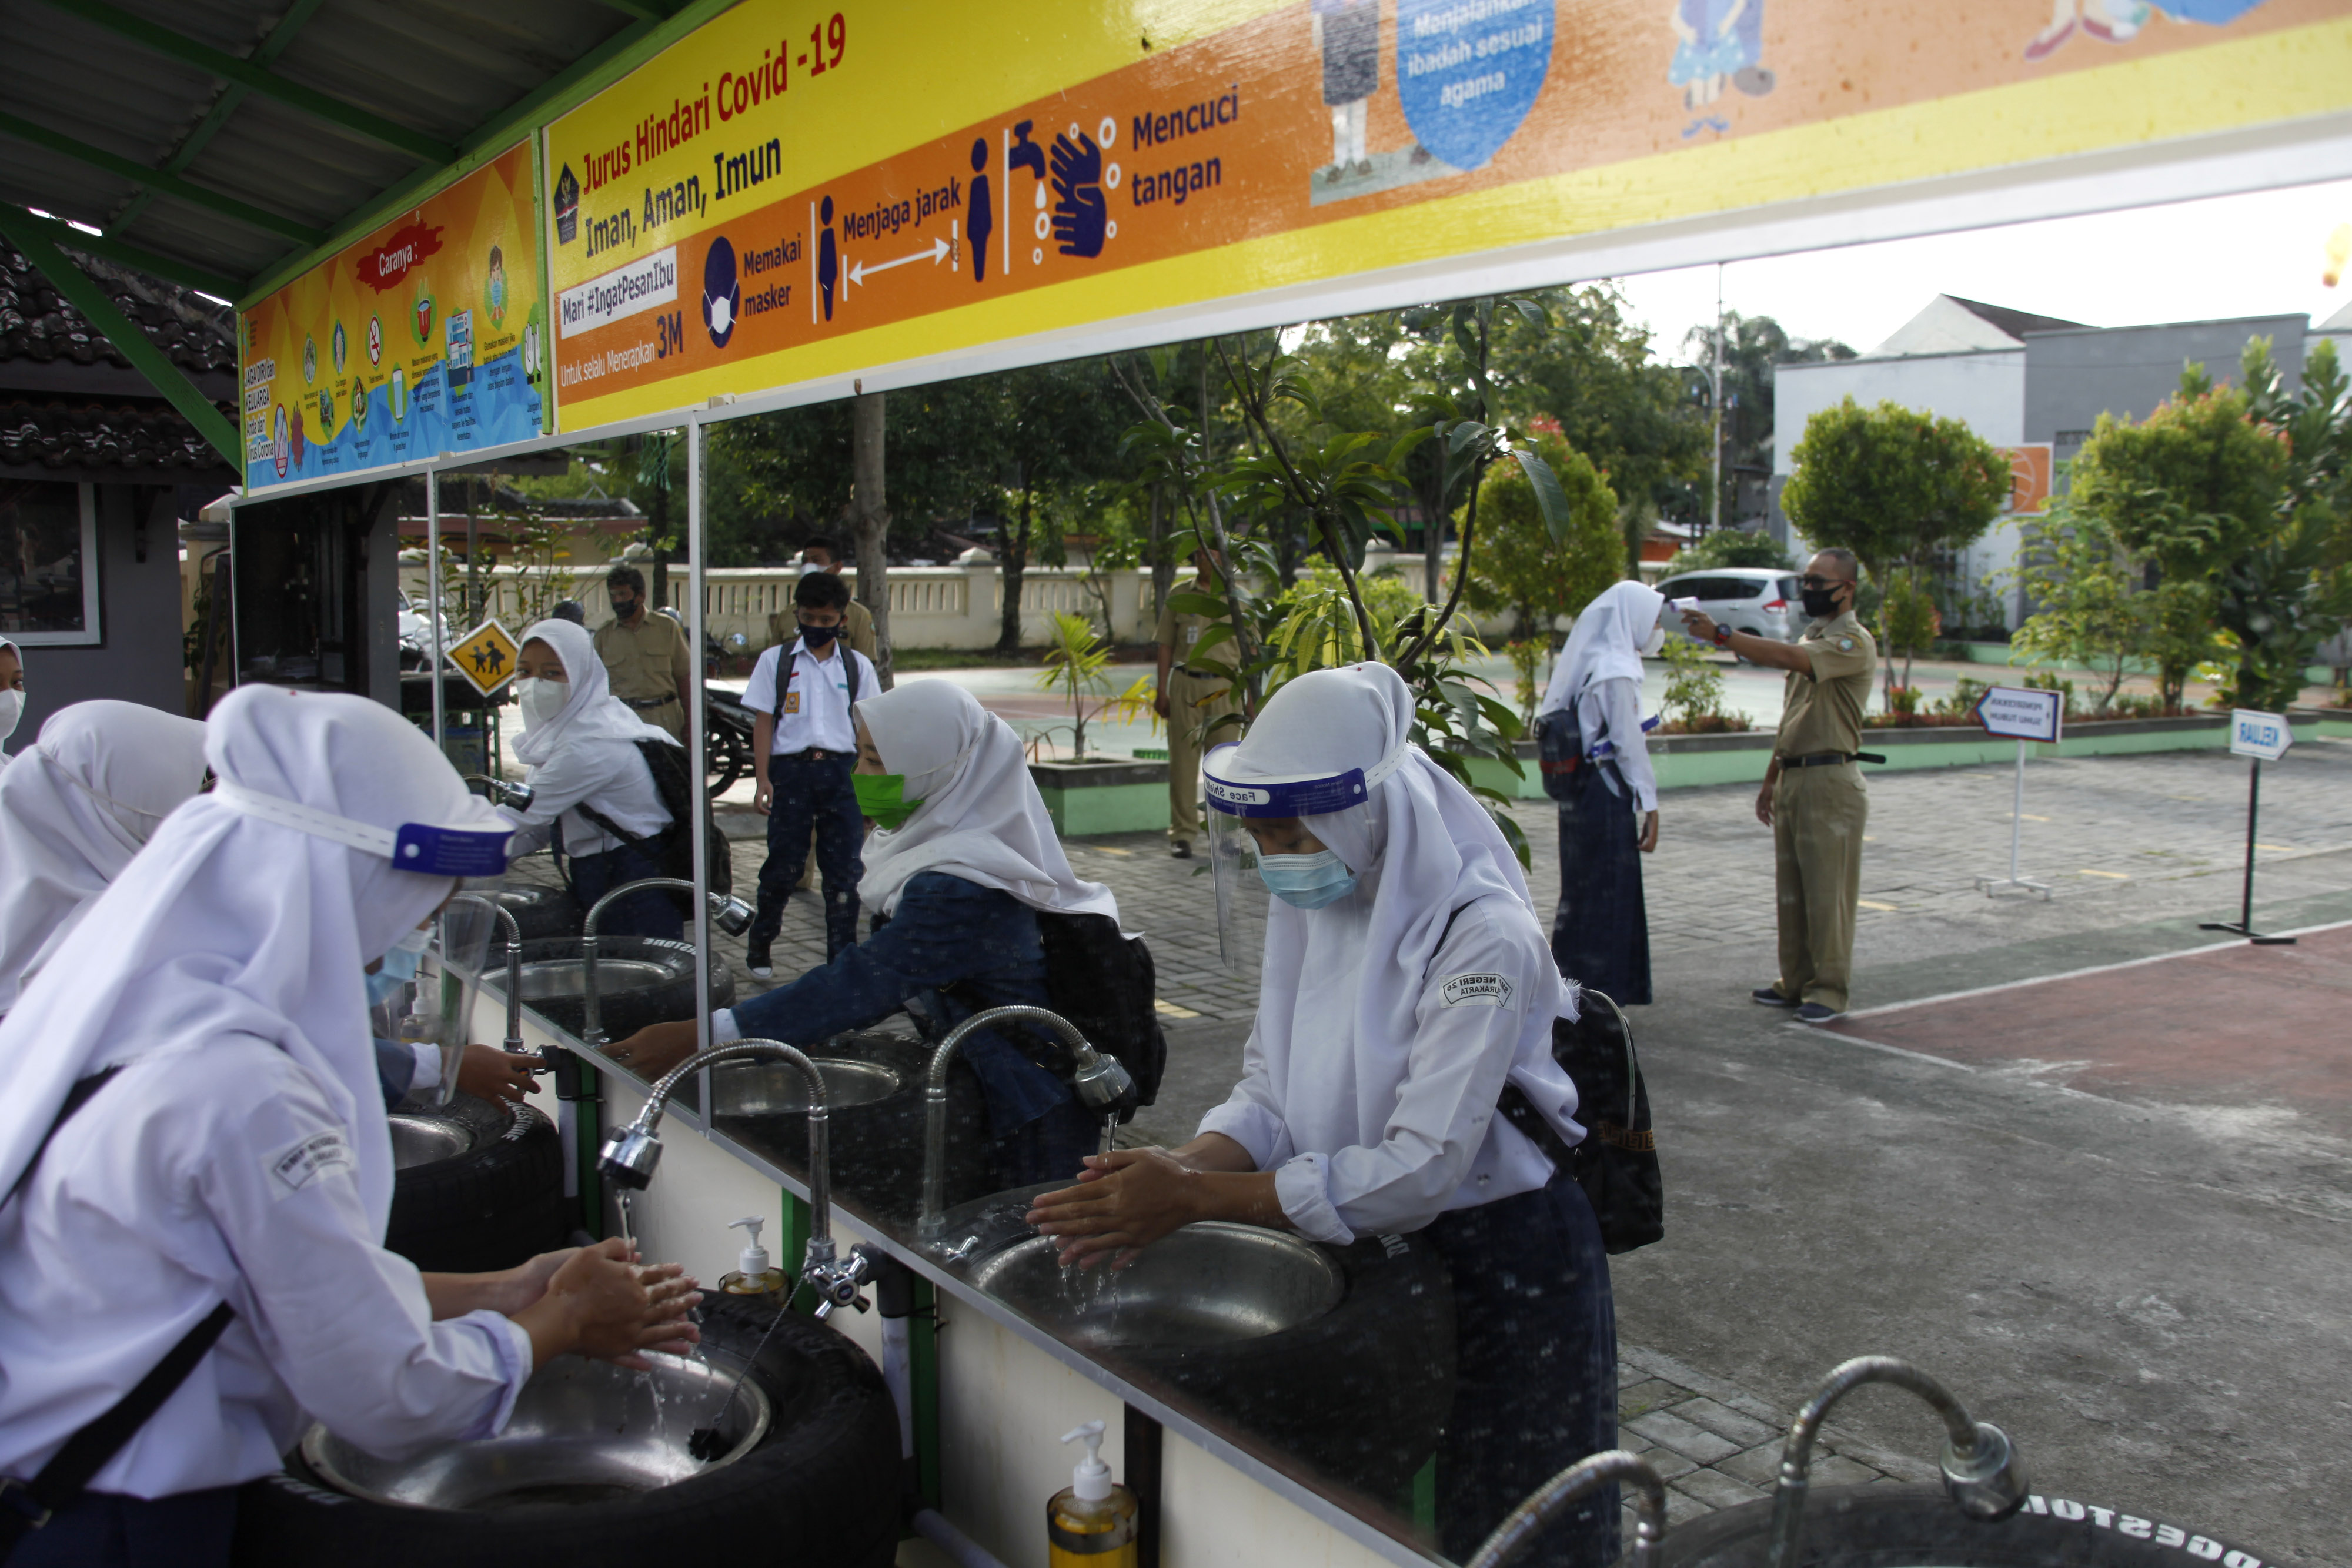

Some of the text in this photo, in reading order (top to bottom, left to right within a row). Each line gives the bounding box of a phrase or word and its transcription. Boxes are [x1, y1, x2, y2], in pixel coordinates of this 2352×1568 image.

[1476, 15, 1543, 58] sesuai
[583, 12, 846, 195] Jurus Hindari Covid -19
[1441, 71, 1505, 108] agama
[1132, 82, 1239, 151] Mencuci
[586, 138, 781, 258] Iman, Aman, Imun
[1132, 155, 1221, 206] tangan
[843, 177, 961, 243] Menjaga jarak
[379, 245, 412, 276] Caranya
[744, 234, 802, 278] Memakai
[563, 260, 674, 325] Mari #IngatPesanIbu
[744, 285, 792, 317] masker
[561, 310, 683, 387] Untuk selalu Menerapkan 3M
[245, 360, 275, 387] JAGA DIRI dan
[246, 390, 269, 412] KELUARGA
[246, 420, 256, 436] Anda
[247, 442, 273, 460] Virus Corona
